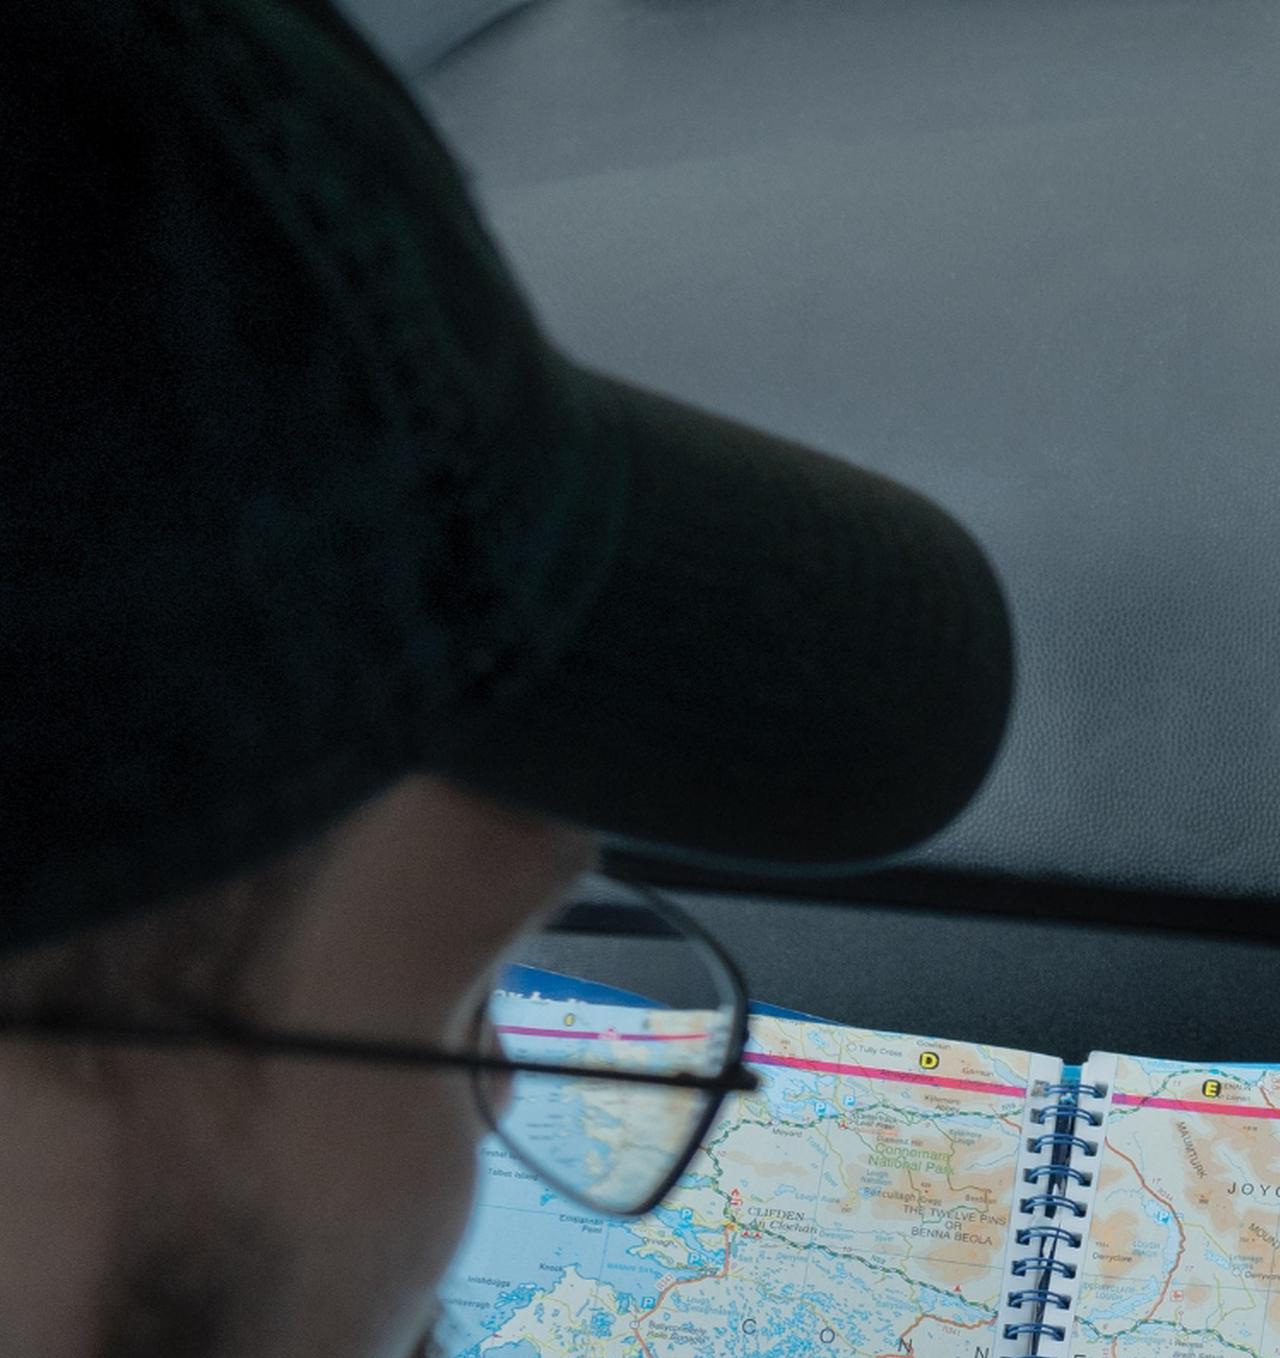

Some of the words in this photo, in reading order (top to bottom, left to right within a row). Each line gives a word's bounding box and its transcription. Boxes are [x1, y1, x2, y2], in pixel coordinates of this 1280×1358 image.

[921, 1053, 938, 1069] D
[1204, 1081, 1219, 1097] E
[903, 1204, 926, 1217] THE
